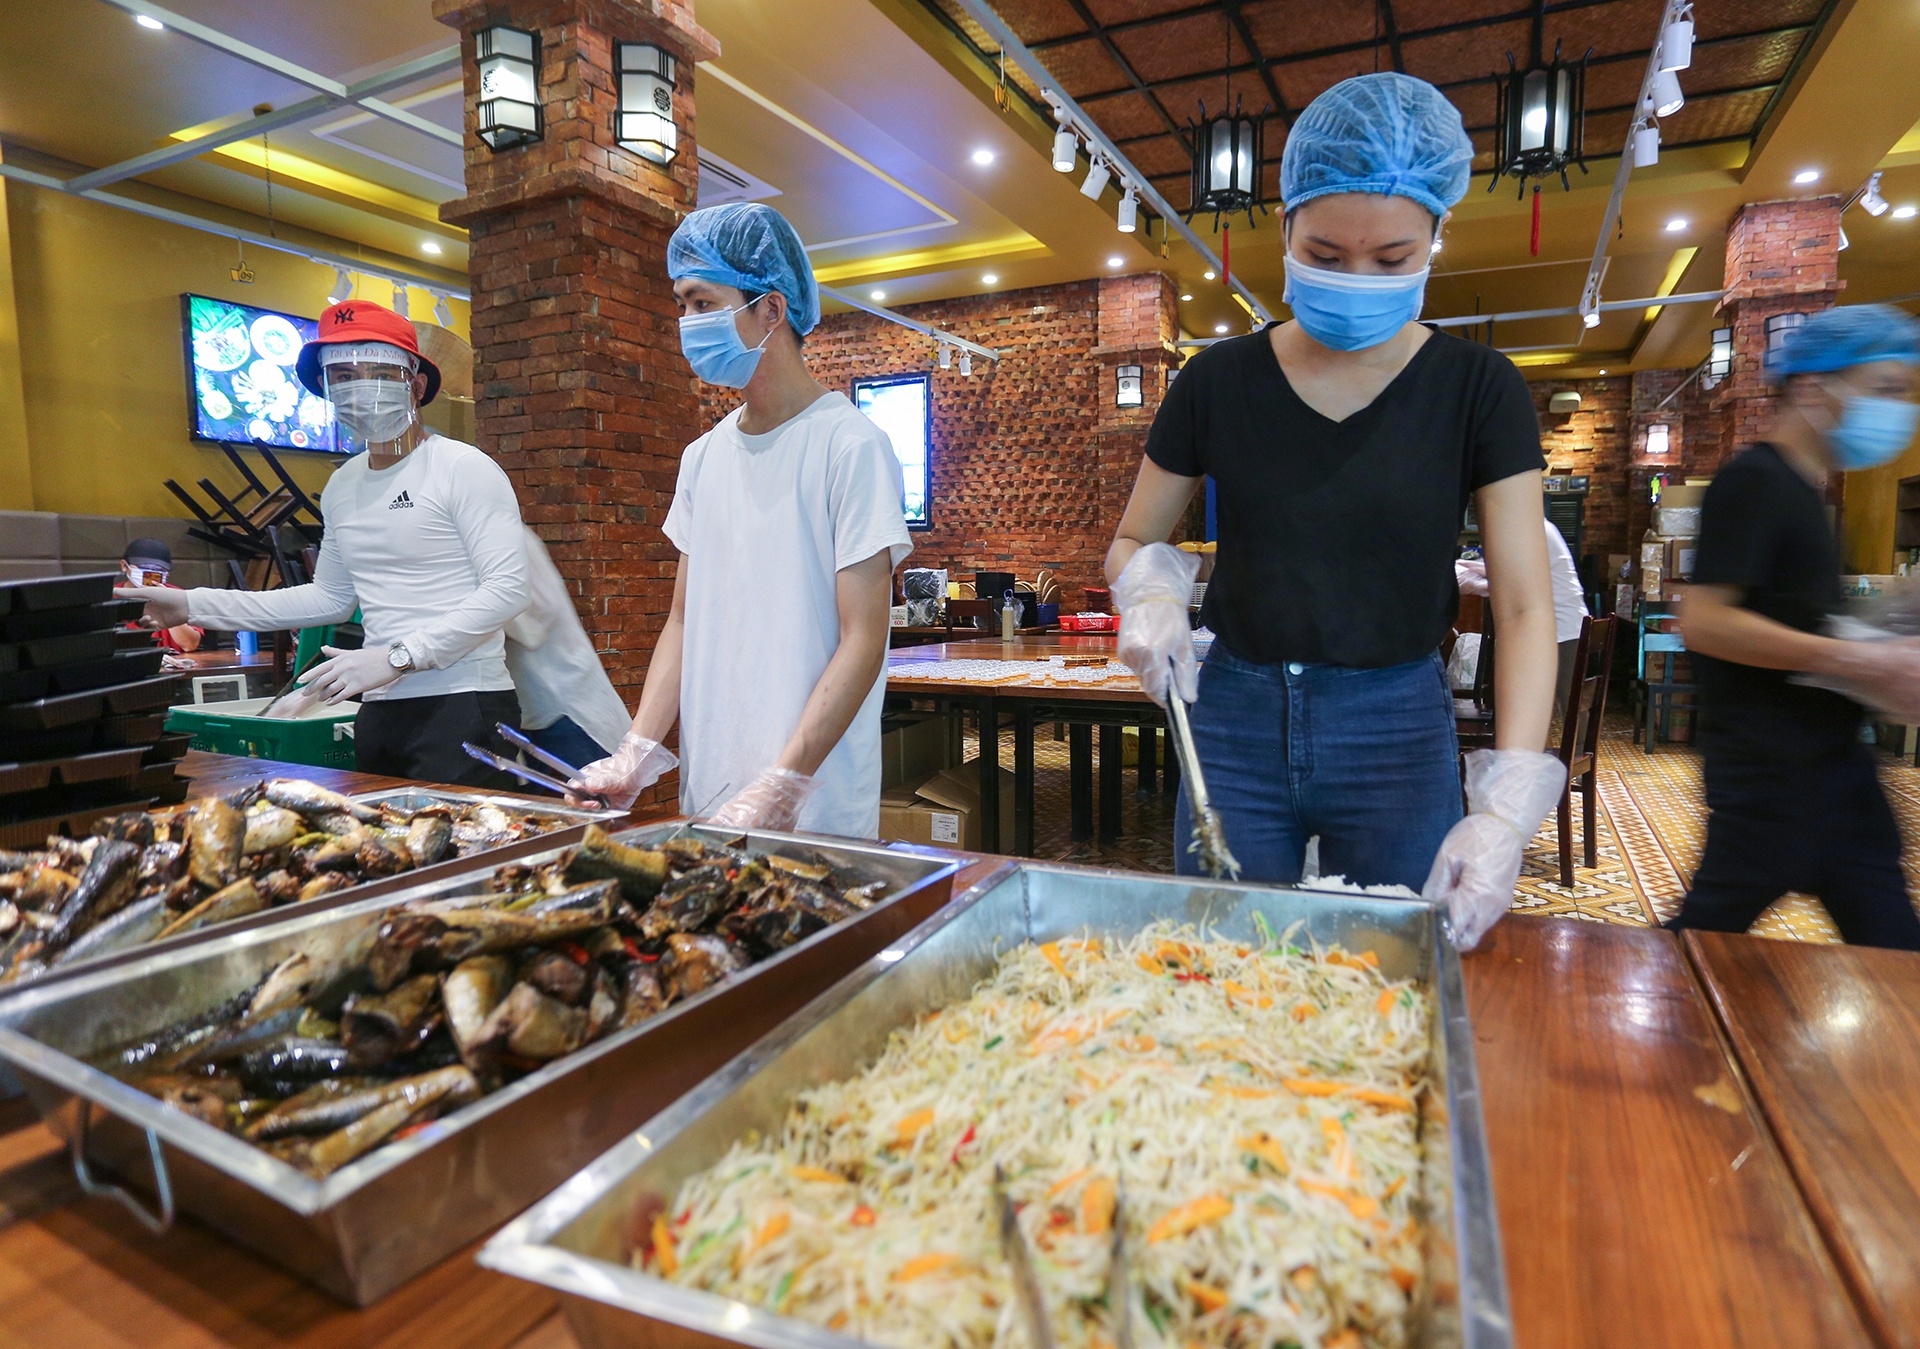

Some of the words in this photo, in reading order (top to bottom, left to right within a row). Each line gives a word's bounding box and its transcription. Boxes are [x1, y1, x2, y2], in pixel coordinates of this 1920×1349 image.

[334, 308, 354, 325] NY
[388, 501, 414, 510] adidas
[323, 750, 350, 762] TEA
